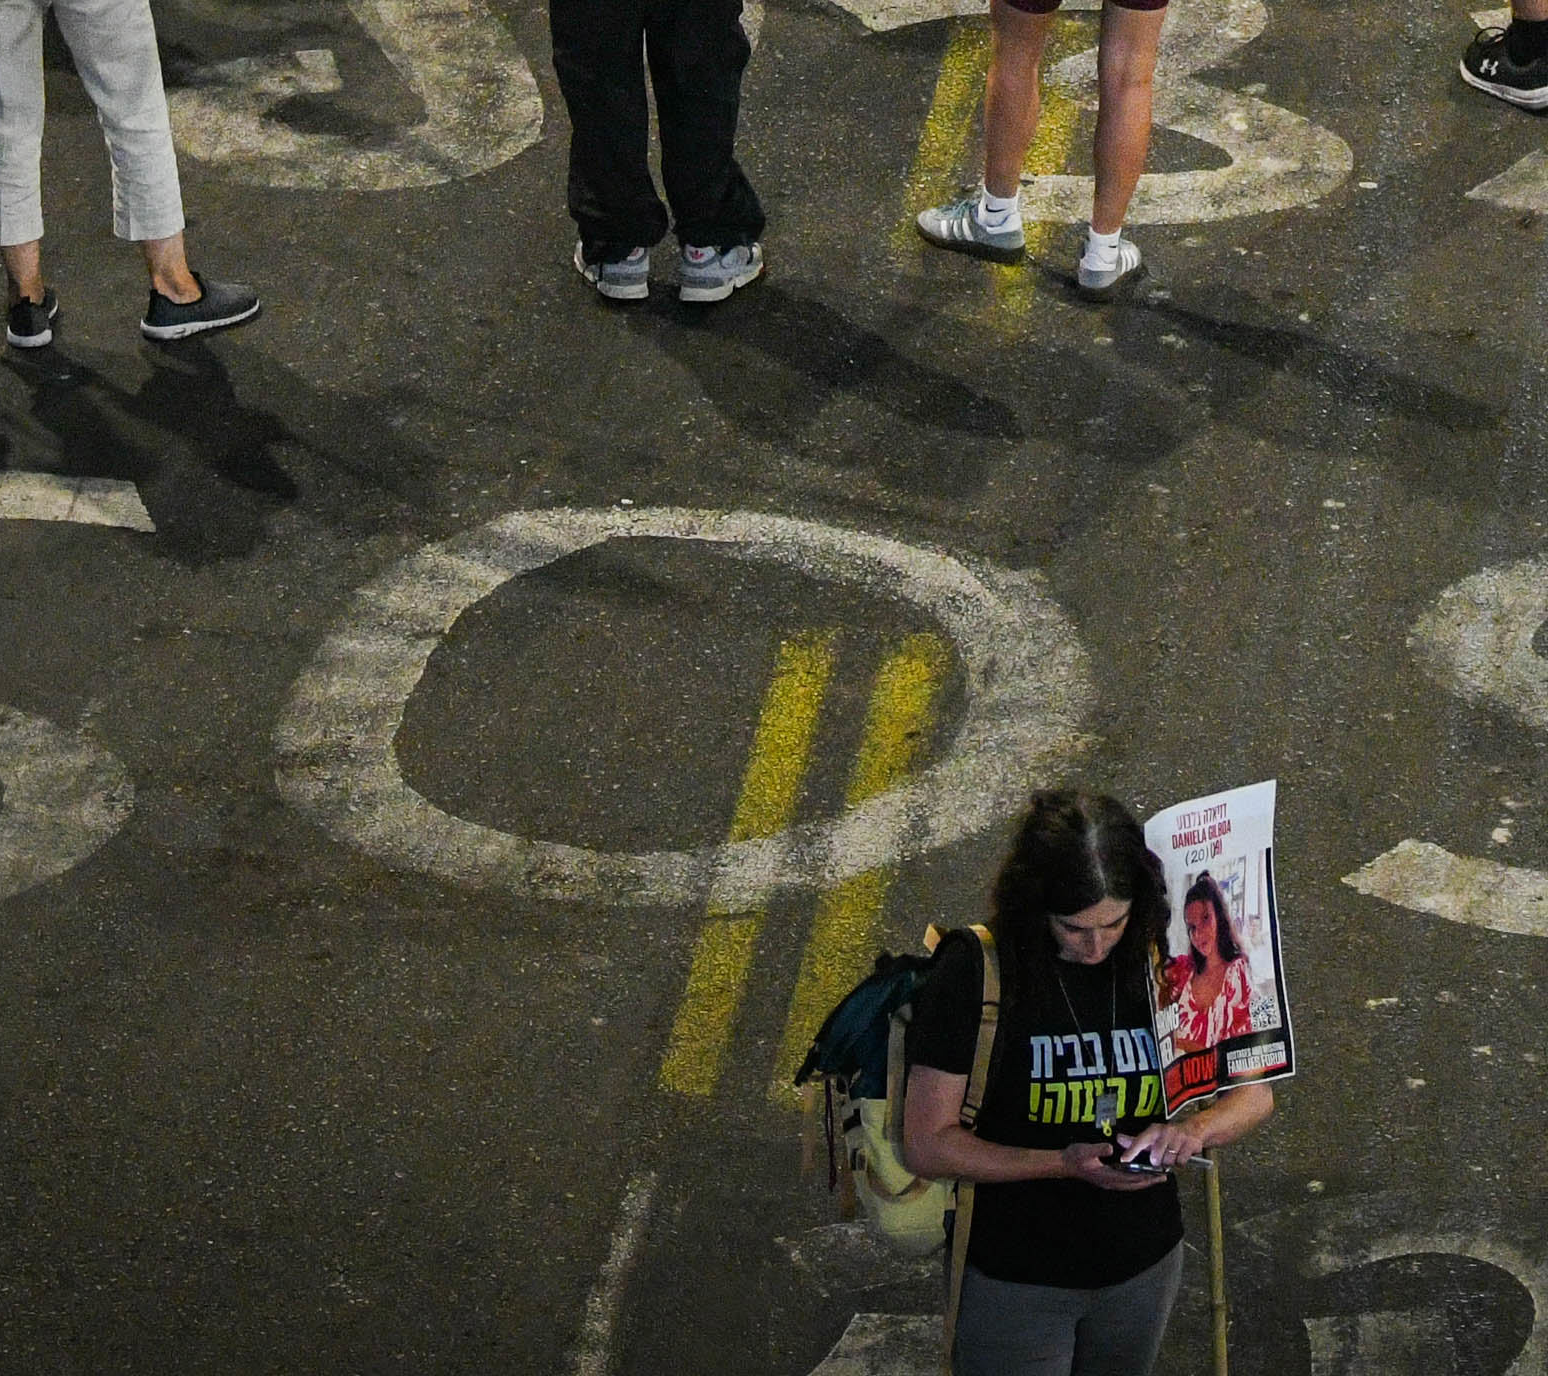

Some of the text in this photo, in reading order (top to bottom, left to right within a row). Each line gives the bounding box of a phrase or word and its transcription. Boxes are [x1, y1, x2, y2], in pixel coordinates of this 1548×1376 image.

[1171, 824, 1231, 851] DANIELA GILBOA
[1184, 847, 1209, 866] (20)
[1030, 1032, 1107, 1079] בבית
